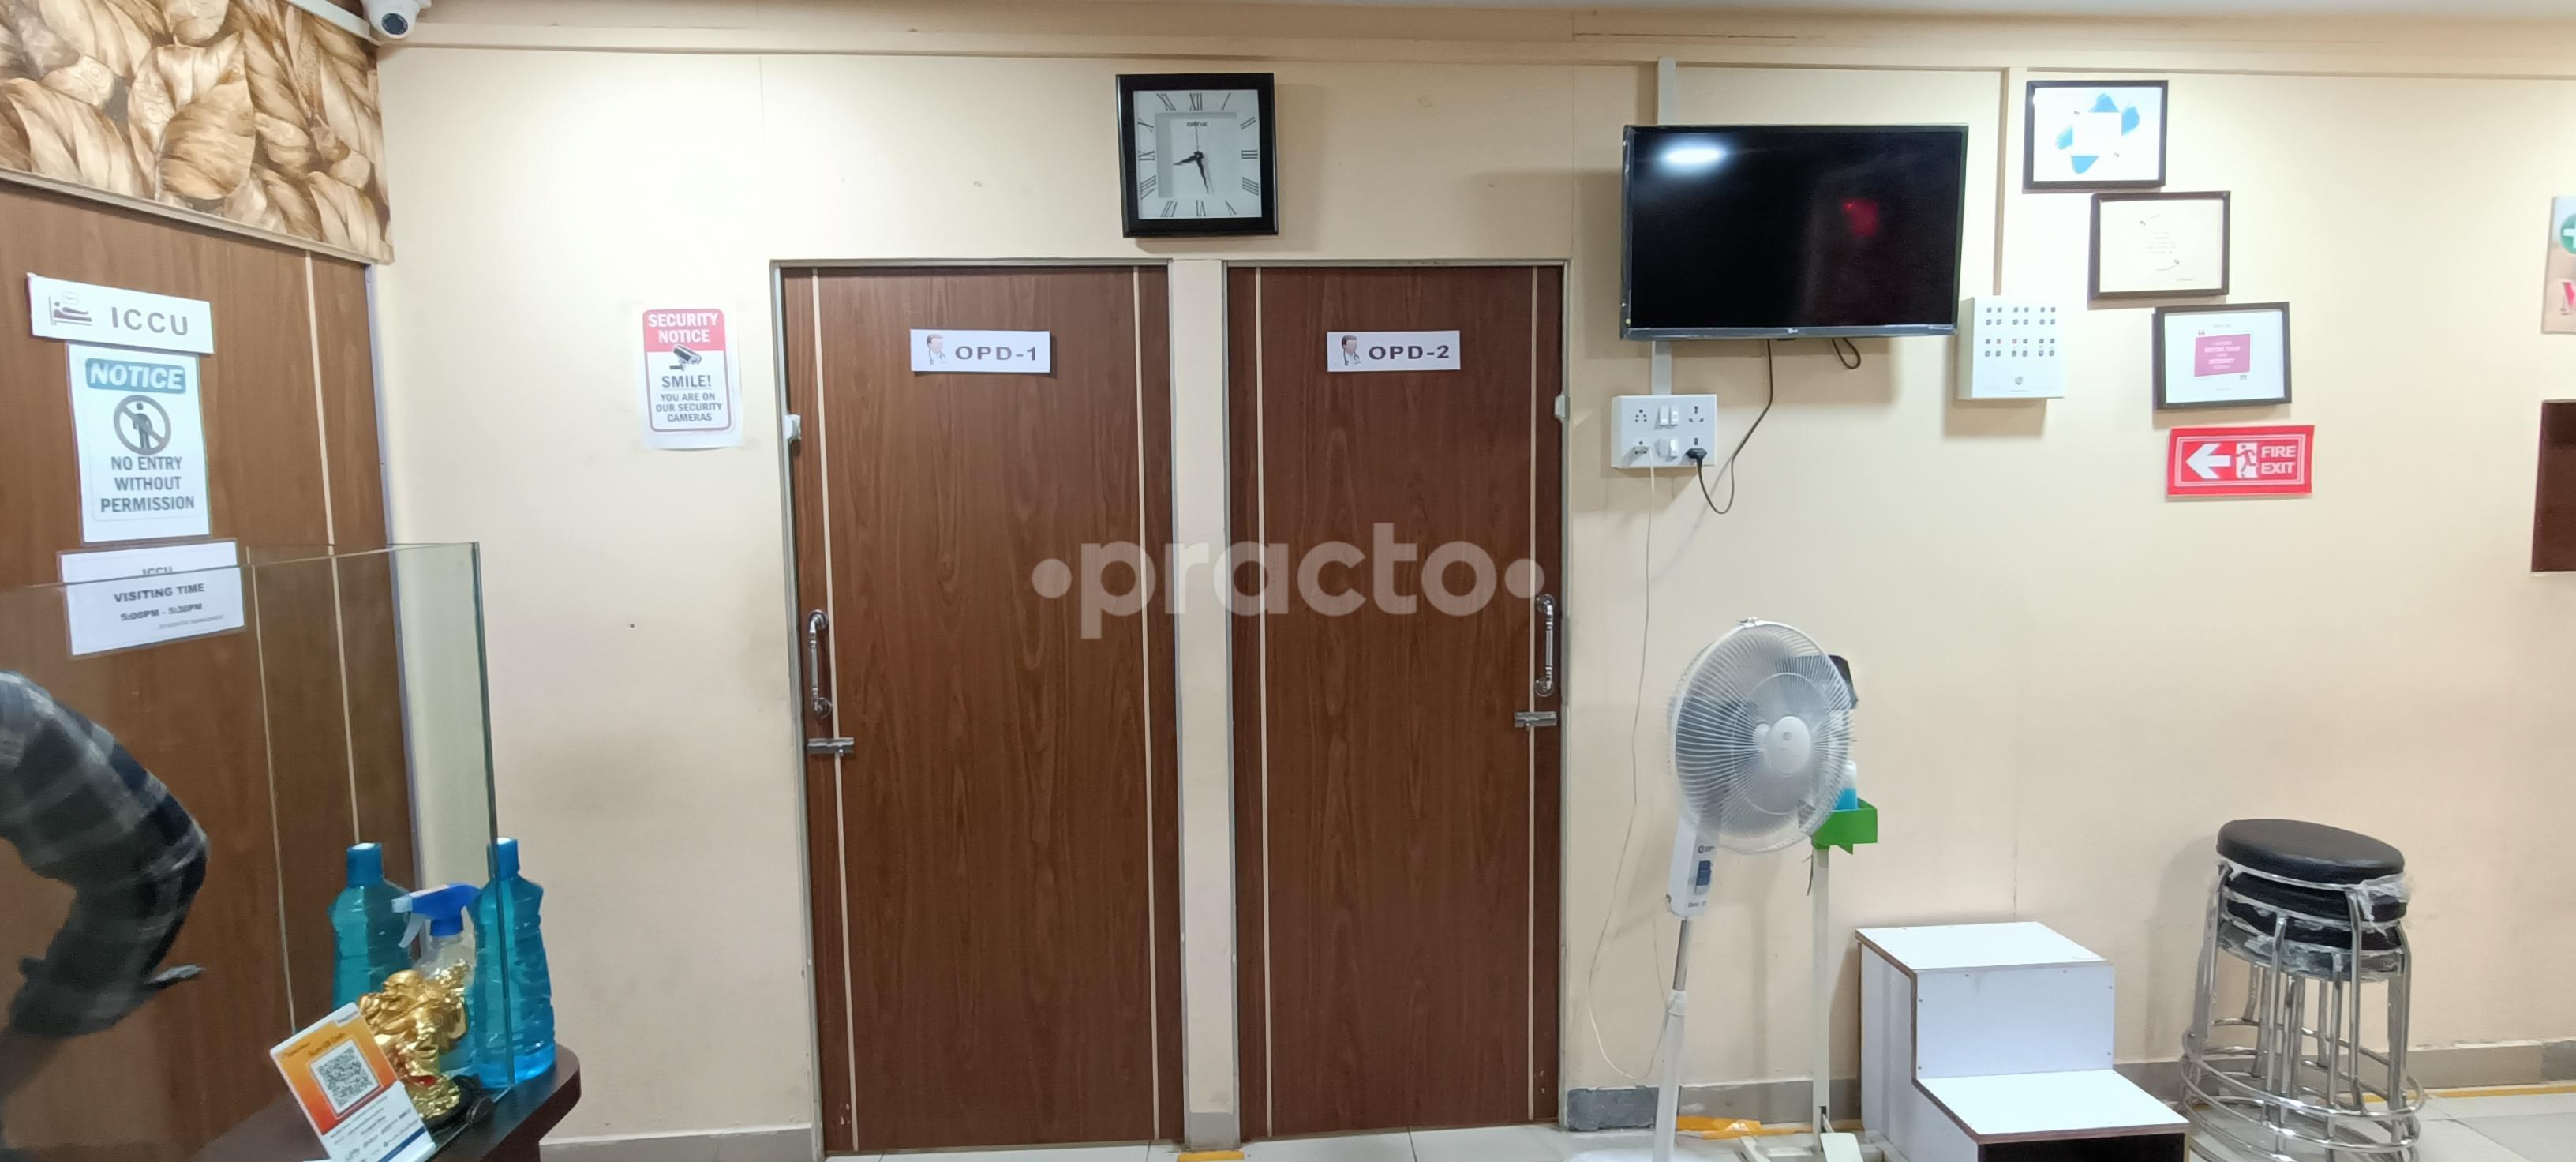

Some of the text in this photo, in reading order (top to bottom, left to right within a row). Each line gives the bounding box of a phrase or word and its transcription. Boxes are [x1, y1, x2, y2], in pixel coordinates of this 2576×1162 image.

[1189, 92, 1204, 111] XII
[1241, 149, 1258, 159] III
[111, 306, 189, 336] ICCU
[648, 312, 719, 328] SECURITY
[658, 329, 710, 343] NOTICE
[954, 345, 1039, 362] OPD-1
[1368, 344, 1451, 361] OPD-2
[89, 362, 185, 391] NOTICE
[661, 374, 712, 388] SMILE!
[660, 392, 716, 402] YOU ARE ON
[656, 403, 723, 412] OUR SECURITY
[667, 413, 713, 422] CAMERAS
[2261, 445, 2297, 458] FIRE
[110, 455, 182, 470] NO ENTRY
[2260, 461, 2296, 474] EXIT
[114, 476, 182, 491] WITHOUT
[100, 495, 195, 513] PERMISSION
[113, 583, 205, 602] VISITING TIME
